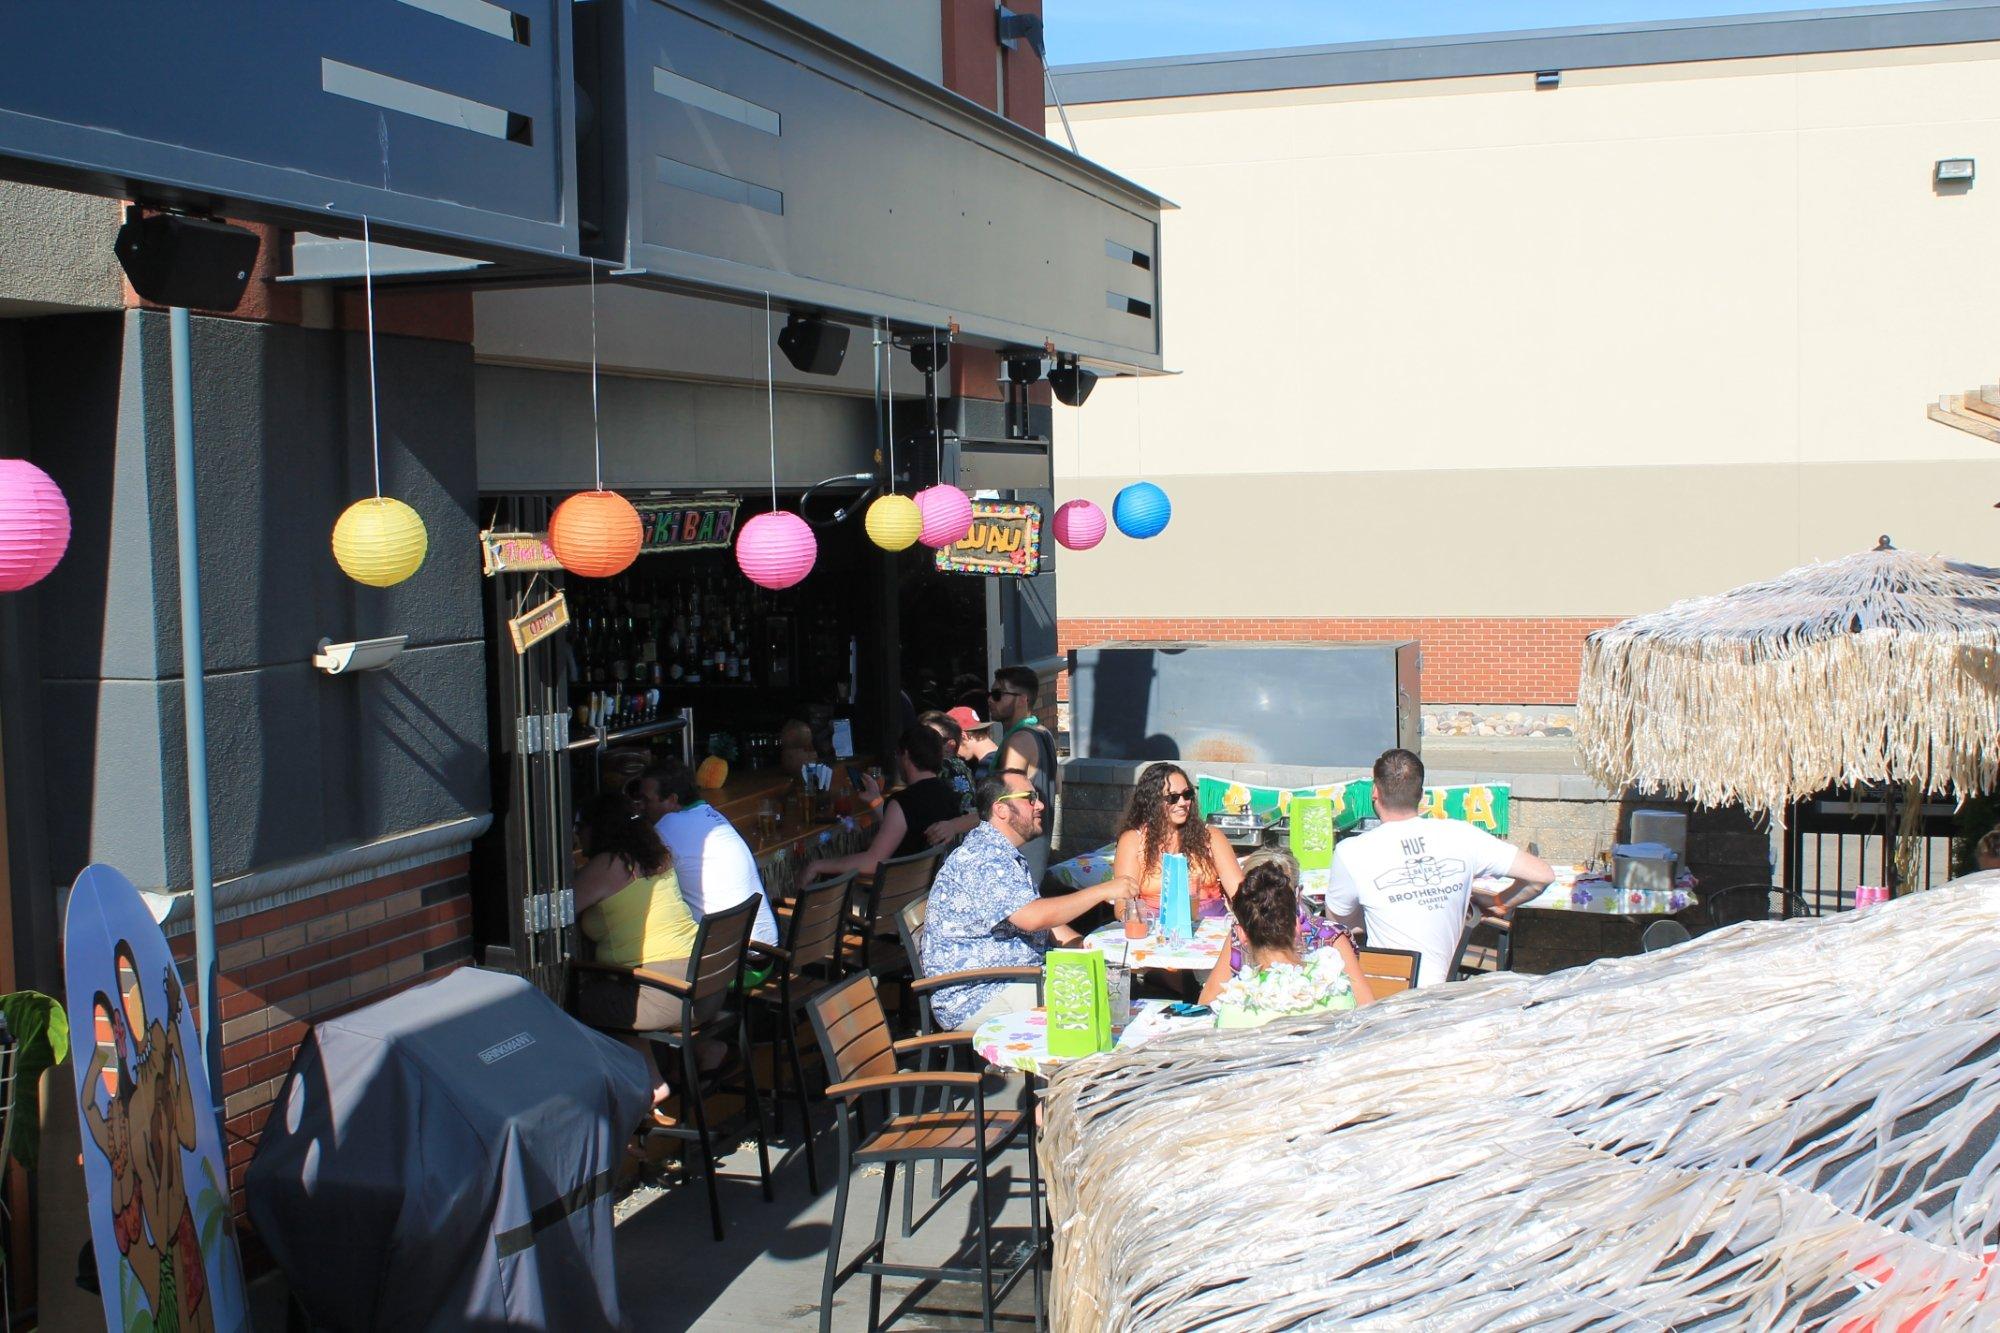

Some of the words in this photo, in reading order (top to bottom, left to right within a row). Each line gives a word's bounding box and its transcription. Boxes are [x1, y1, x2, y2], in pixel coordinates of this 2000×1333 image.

[640, 511, 681, 545] iKi
[683, 510, 732, 541] BAR
[1401, 836, 1426, 856] HUF
[480, 1035, 530, 1063] BRINKMANN
